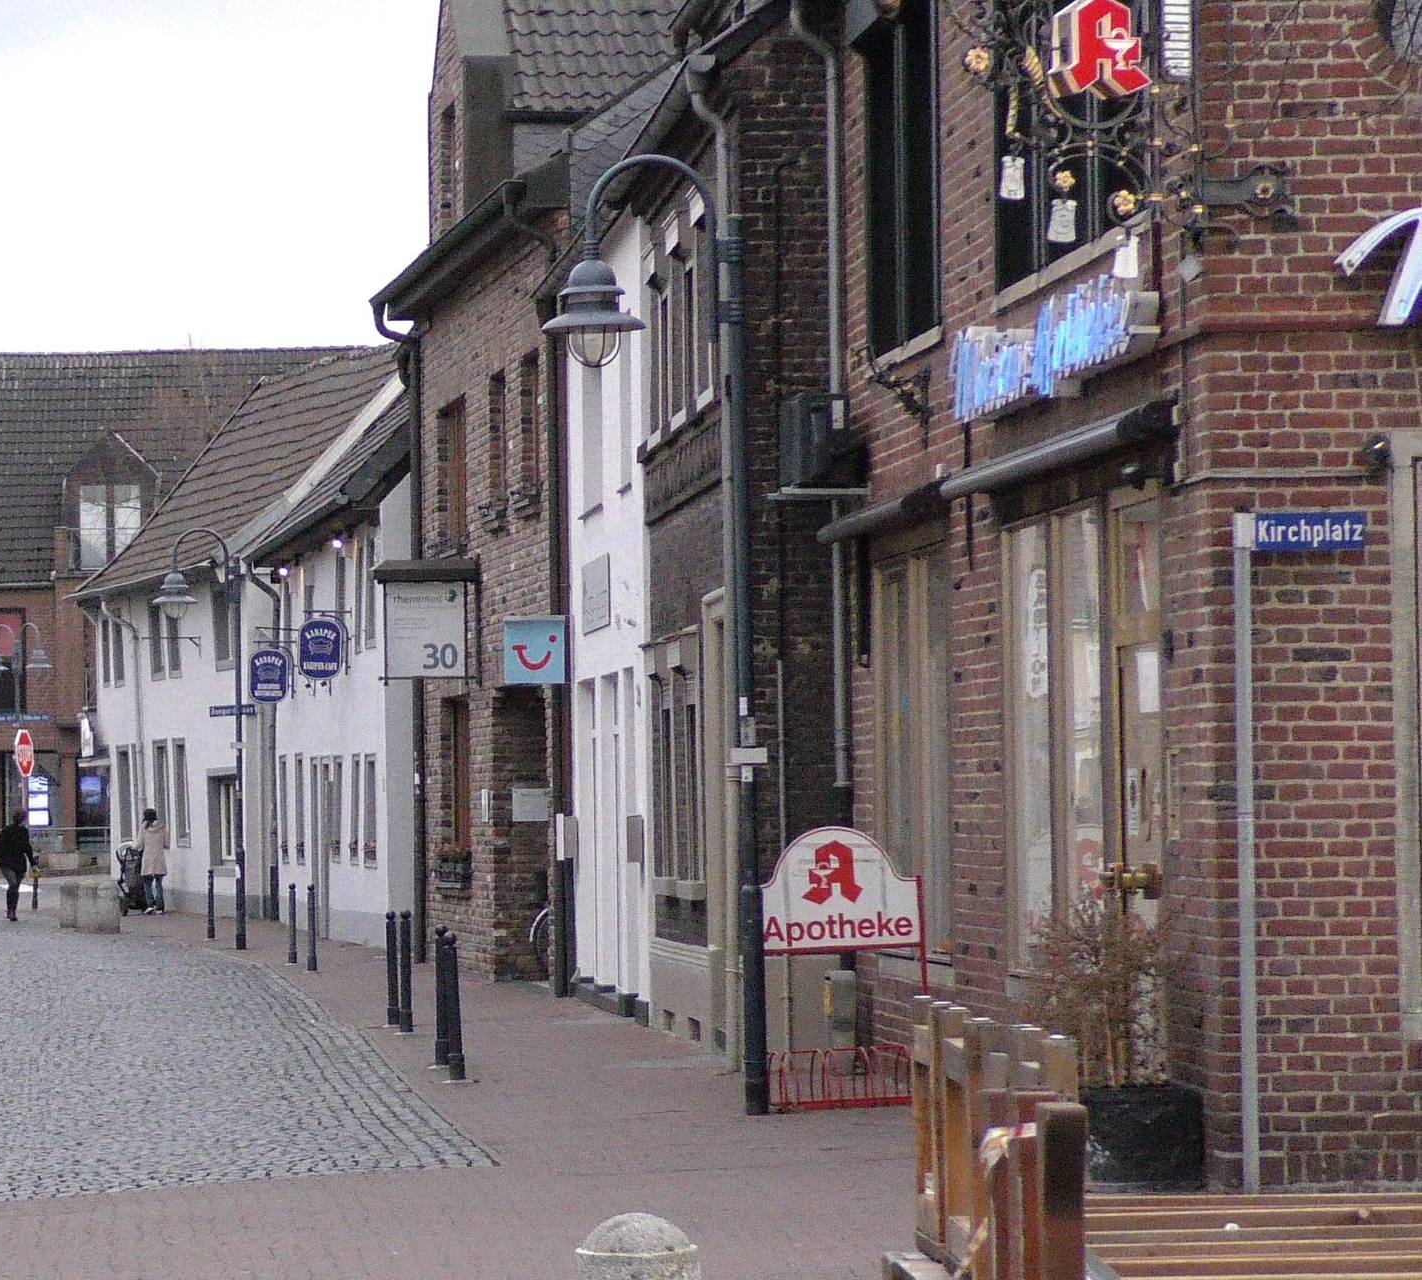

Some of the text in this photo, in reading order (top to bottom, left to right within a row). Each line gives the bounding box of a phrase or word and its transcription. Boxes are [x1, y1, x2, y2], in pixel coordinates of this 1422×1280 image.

[1258, 519, 1363, 547] Kirchplatz
[423, 643, 458, 669] 30
[763, 911, 914, 947] Apotheke
